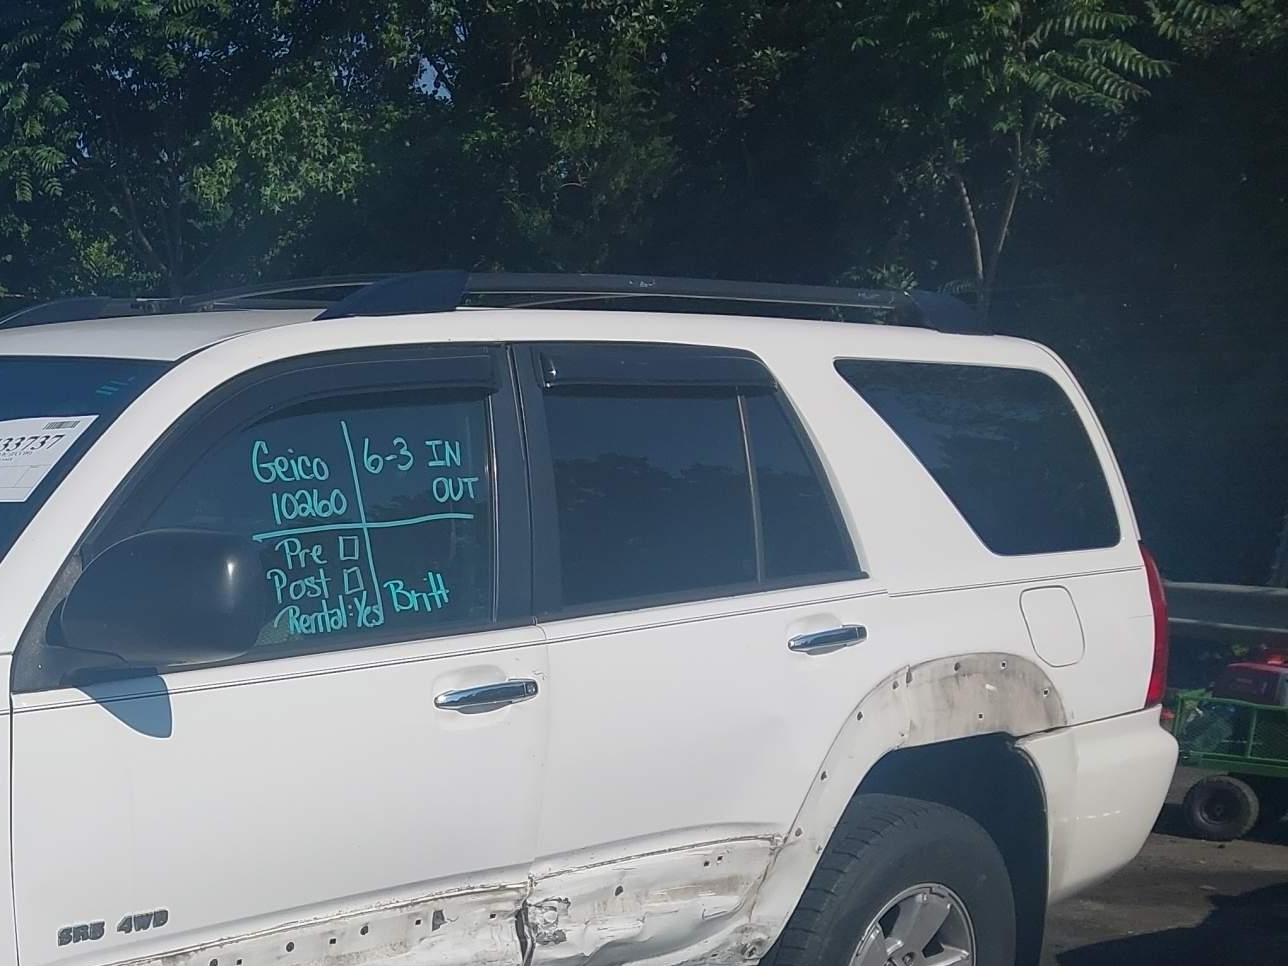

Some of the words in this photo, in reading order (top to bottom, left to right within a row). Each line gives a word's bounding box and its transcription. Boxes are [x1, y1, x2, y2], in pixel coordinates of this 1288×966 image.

[252, 440, 330, 484] Geico
[363, 436, 414, 474] 6-3
[425, 439, 462, 467] IN
[272, 488, 348, 525] 10260
[432, 476, 479, 503] OUT
[274, 537, 328, 570] Pre
[266, 568, 332, 604] Post
[57, 920, 106, 947] SR5
[116, 909, 169, 935] 4WD
